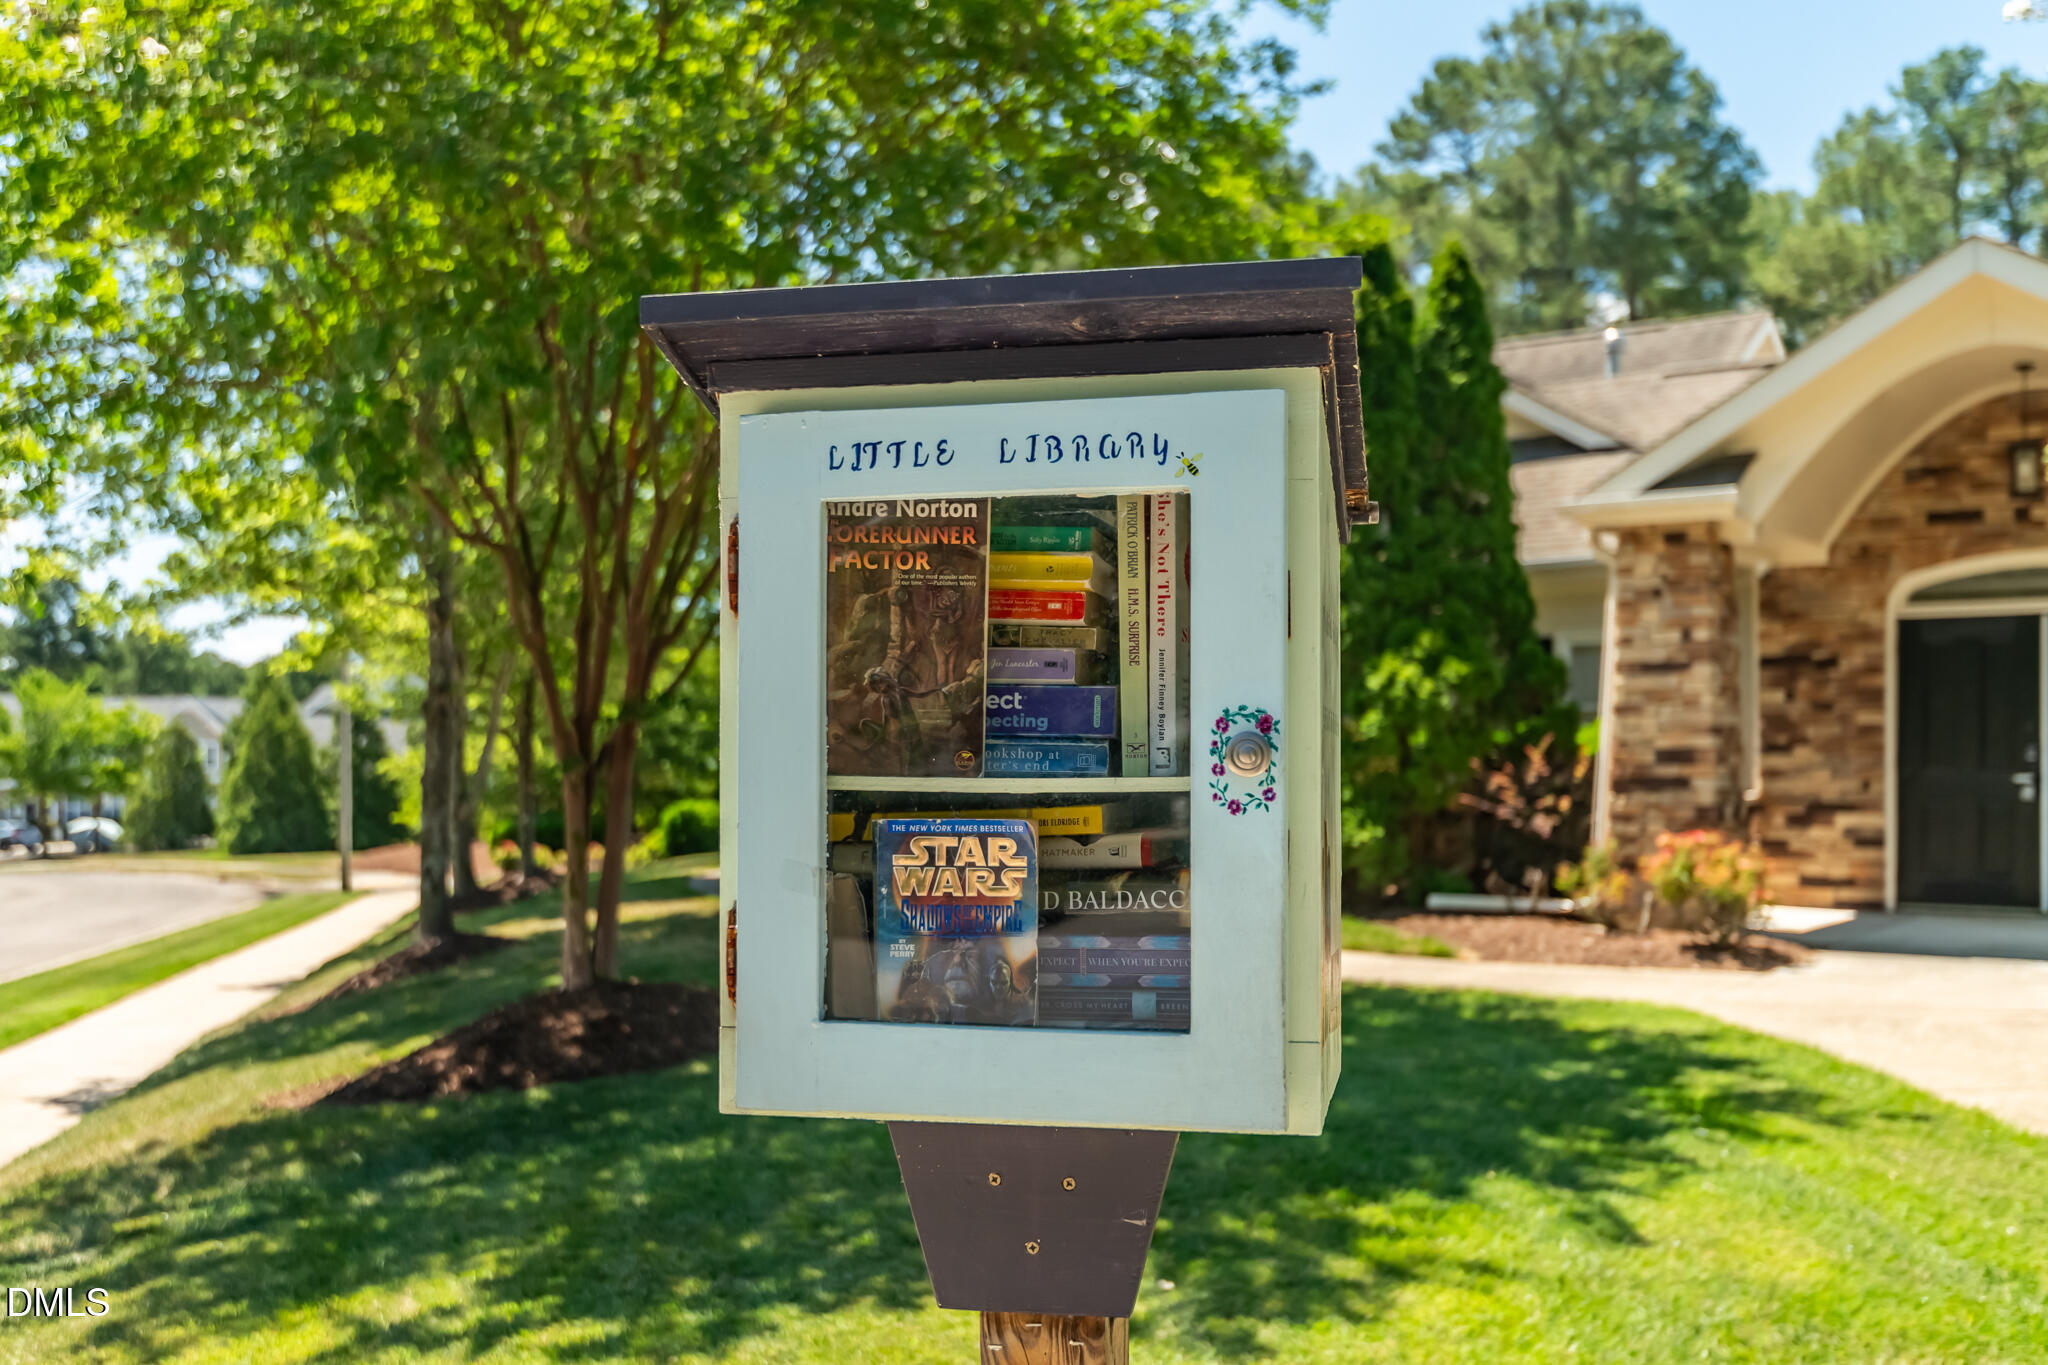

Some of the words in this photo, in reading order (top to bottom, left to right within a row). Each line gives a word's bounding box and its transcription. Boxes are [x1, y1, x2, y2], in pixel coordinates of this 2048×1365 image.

[829, 439, 955, 471] LITTLE
[828, 501, 888, 517] ndre
[896, 500, 977, 518] Norton
[1127, 501, 1139, 539] PATRICK
[827, 525, 977, 545] ORERUNNER
[829, 549, 931, 572] FACTOR
[1127, 541, 1139, 579] O'BRIAN
[1157, 542, 1170, 574] Not
[1127, 588, 1140, 617] H.M.S.
[1157, 580, 1171, 636] There
[1128, 621, 1140, 666] SURPRISE
[1005, 658, 1040, 667] Lancaster
[1158, 648, 1166, 681] Jennifer
[1157, 684, 1166, 711] Finney
[1157, 713, 1166, 741] Boylan
[1024, 761, 1049, 771] end
[1048, 751, 1060, 760] at
[1051, 817, 1080, 826] ELDRIDGE
[892, 836, 1028, 867] STAR
[1041, 848, 1095, 857] HATMAKER
[893, 867, 1028, 897] WARS
[1044, 891, 1060, 910] D
[901, 899, 960, 931] SHADOWS
[975, 901, 1023, 932] EMPIRE
[1041, 957, 1076, 965] EXPECT
[1088, 957, 1119, 966] WHEN
[1086, 1001, 1098, 1009] MY
[1101, 1001, 1128, 1009] HEART
